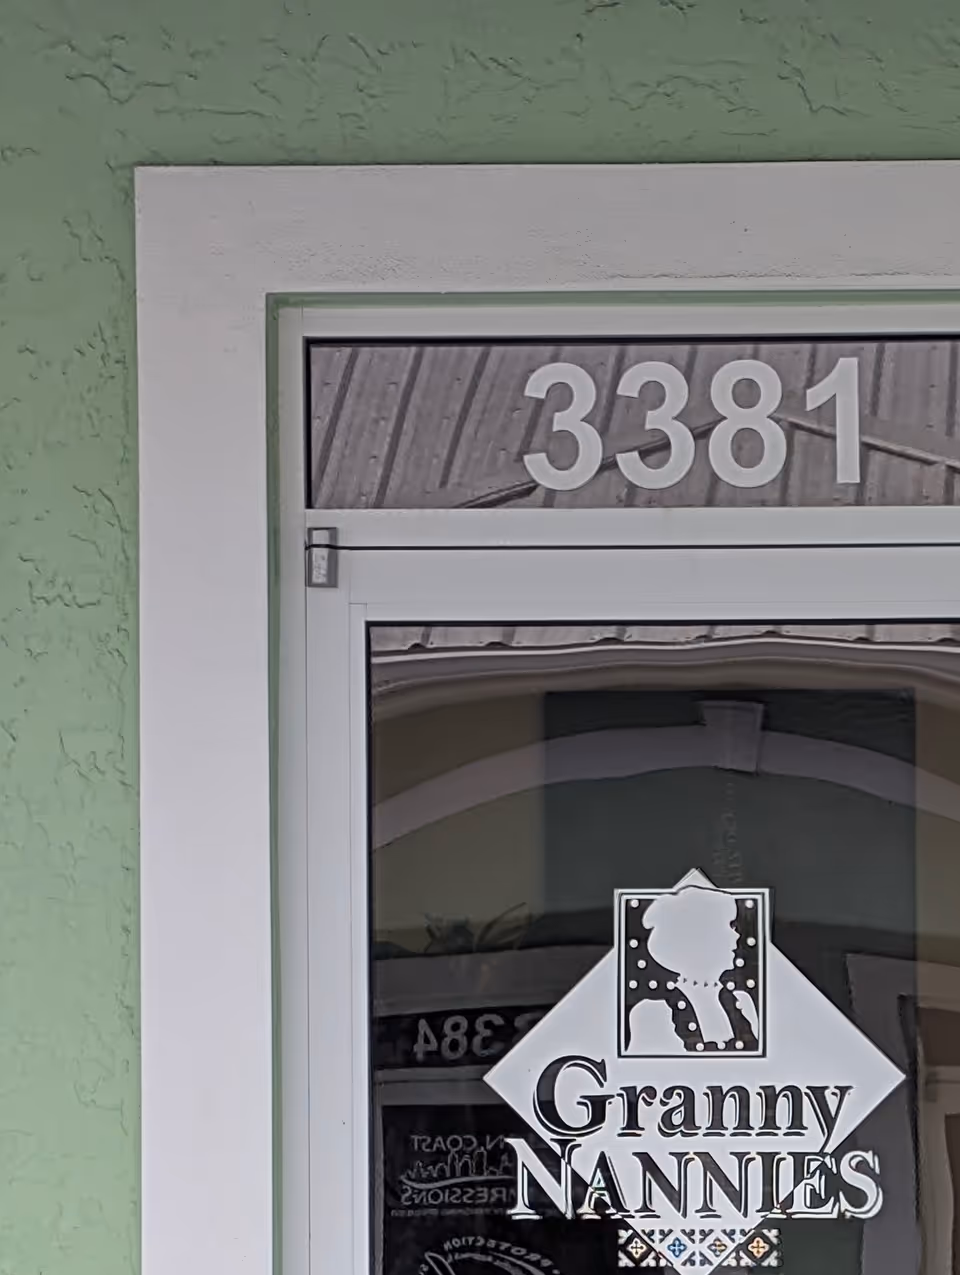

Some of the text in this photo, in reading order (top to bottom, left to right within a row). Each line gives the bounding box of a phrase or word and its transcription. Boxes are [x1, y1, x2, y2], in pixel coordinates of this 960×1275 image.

[523, 357, 862, 491] 3381
[532, 1055, 856, 1153] Granny
[505, 1137, 885, 1220] NANNIES
